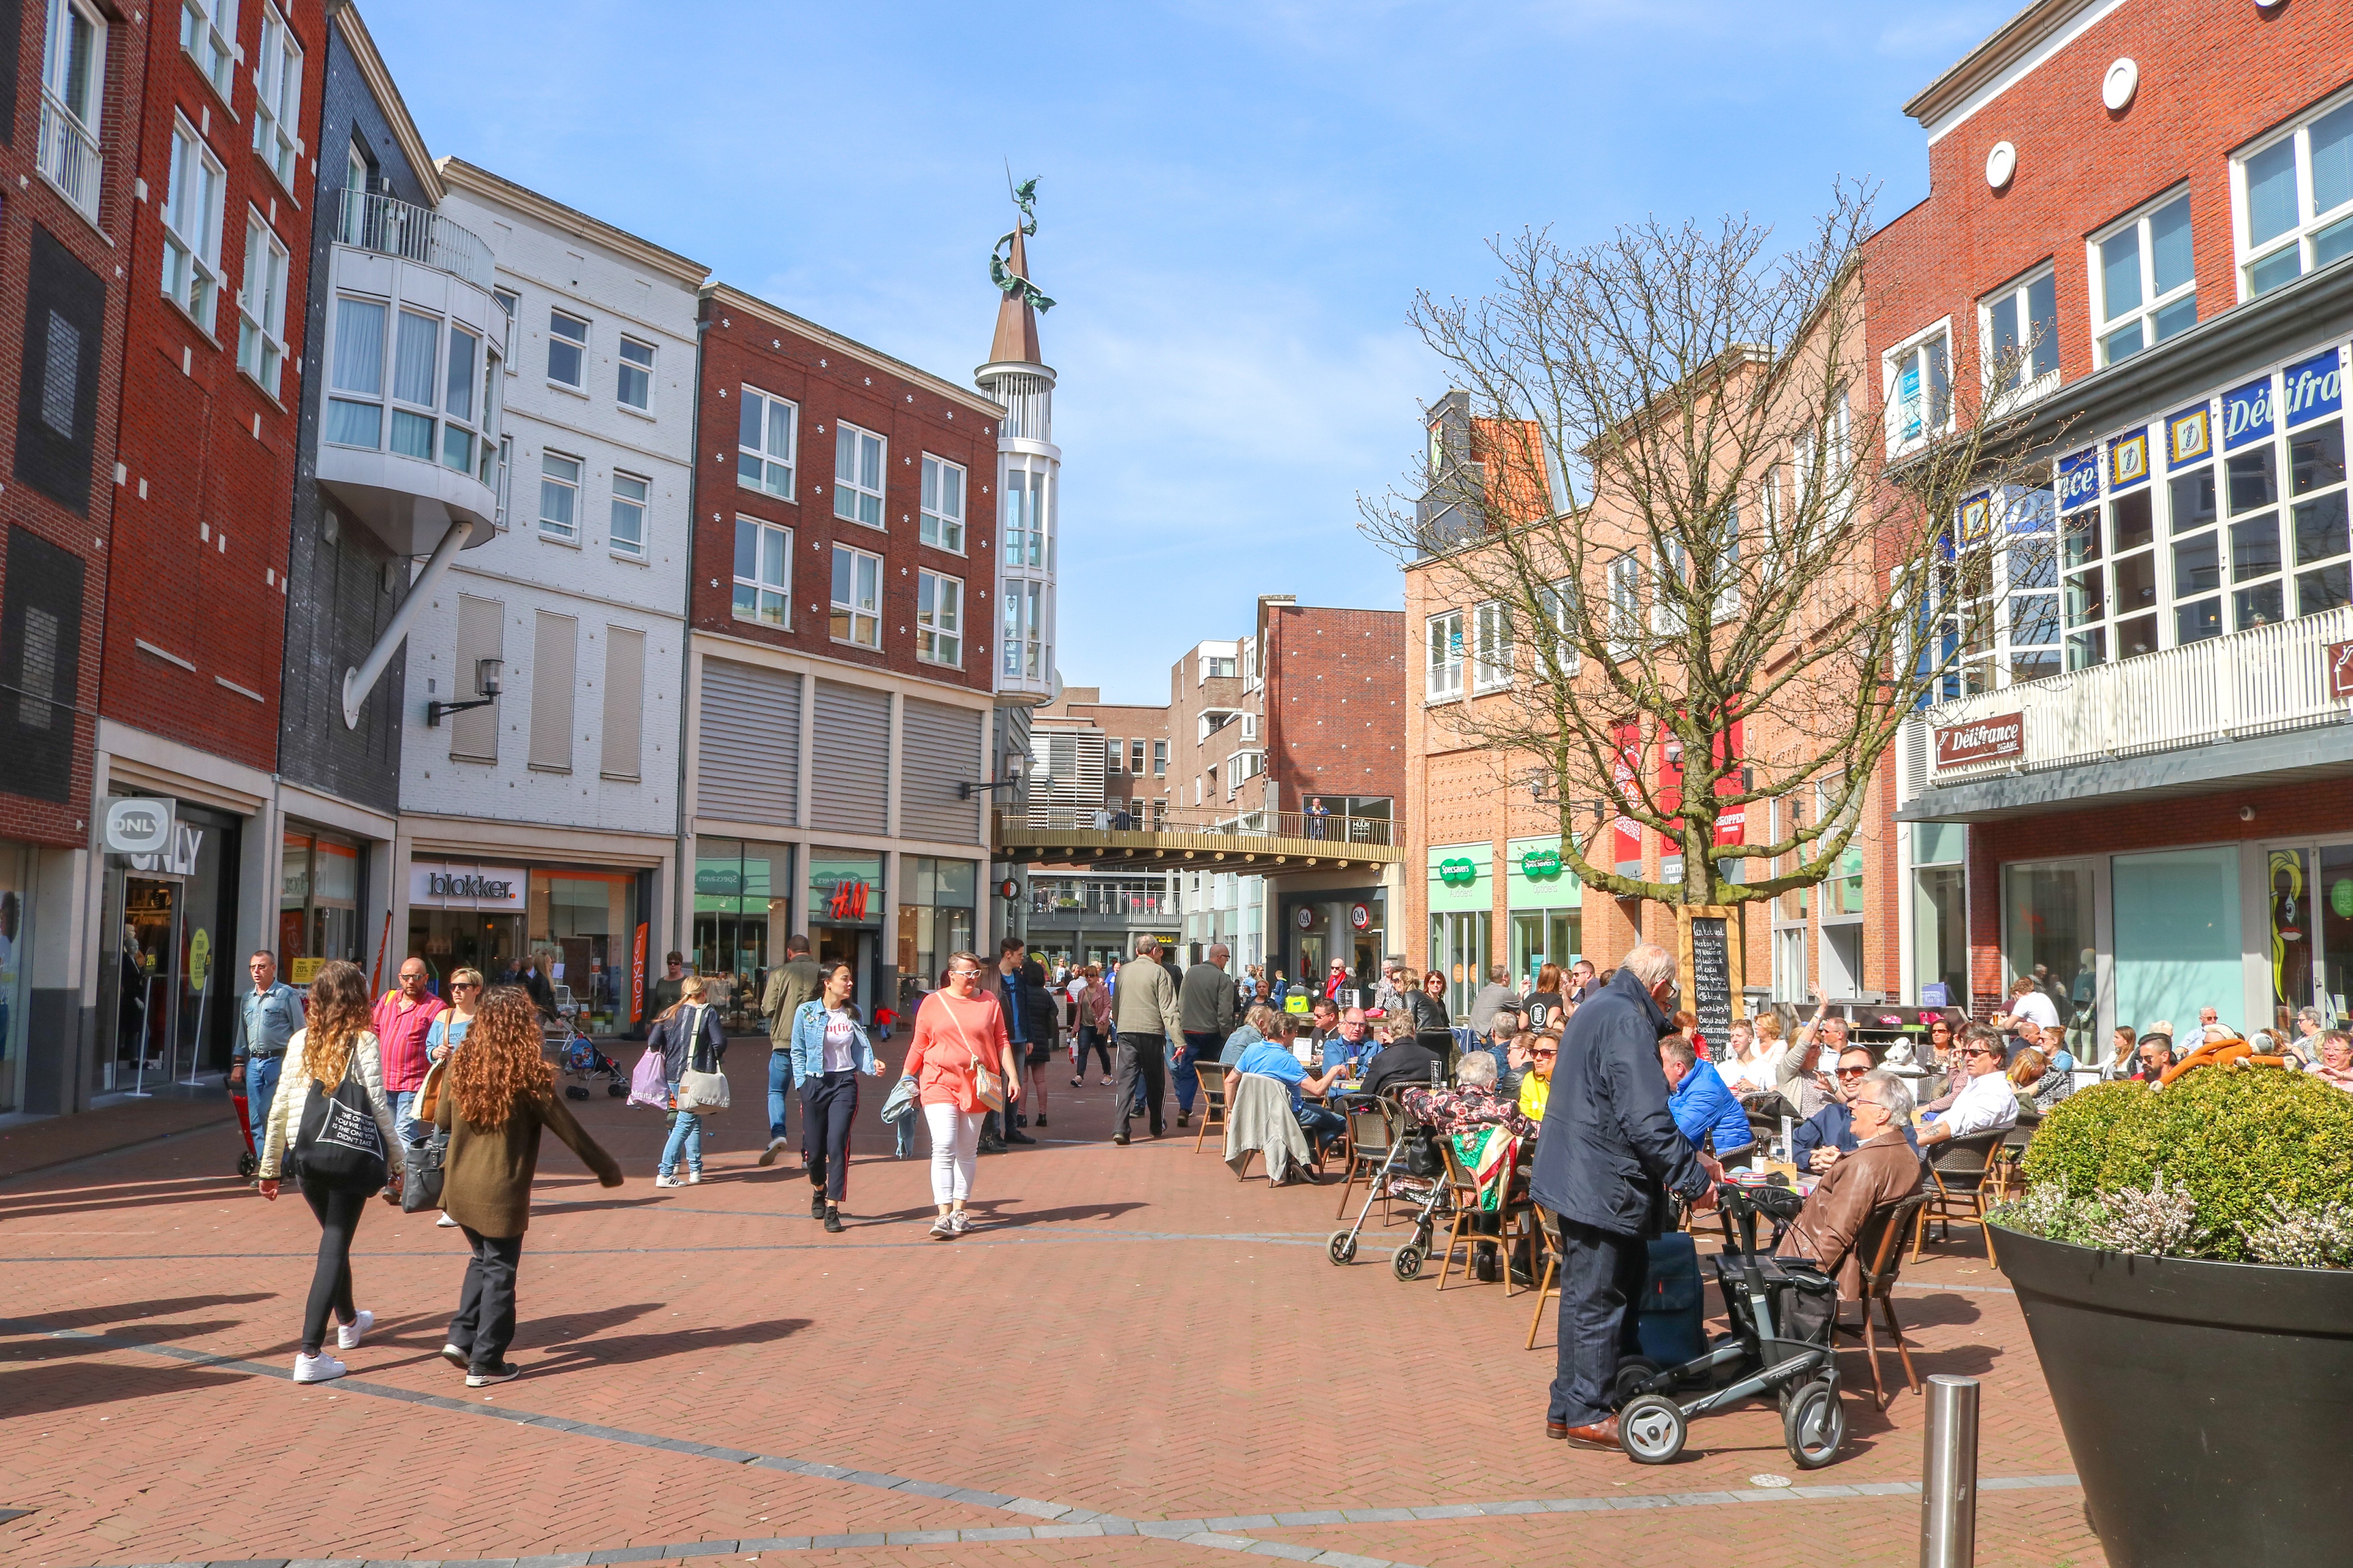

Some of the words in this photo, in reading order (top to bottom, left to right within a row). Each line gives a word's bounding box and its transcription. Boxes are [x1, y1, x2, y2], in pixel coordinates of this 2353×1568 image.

[1952, 724, 2018, 751] Délifrance
[1997, 740, 2017, 751] INGANG
[111, 818, 164, 832] ONLY
[1442, 865, 1469, 875] Specsavers
[1450, 889, 1472, 897] Audiciens
[1533, 884, 1558, 895] Opticiens
[831, 881, 870, 921] H&M
[1299, 913, 1310, 923] C&A
[1354, 910, 1364, 921] C&A
[342, 1111, 352, 1120] THE
[335, 1116, 349, 1126] YOU
[349, 1121, 362, 1131] WILL
[339, 1125, 351, 1134] THE
[350, 1129, 364, 1138] ONE
[337, 1132, 359, 1144] DIDN'T
